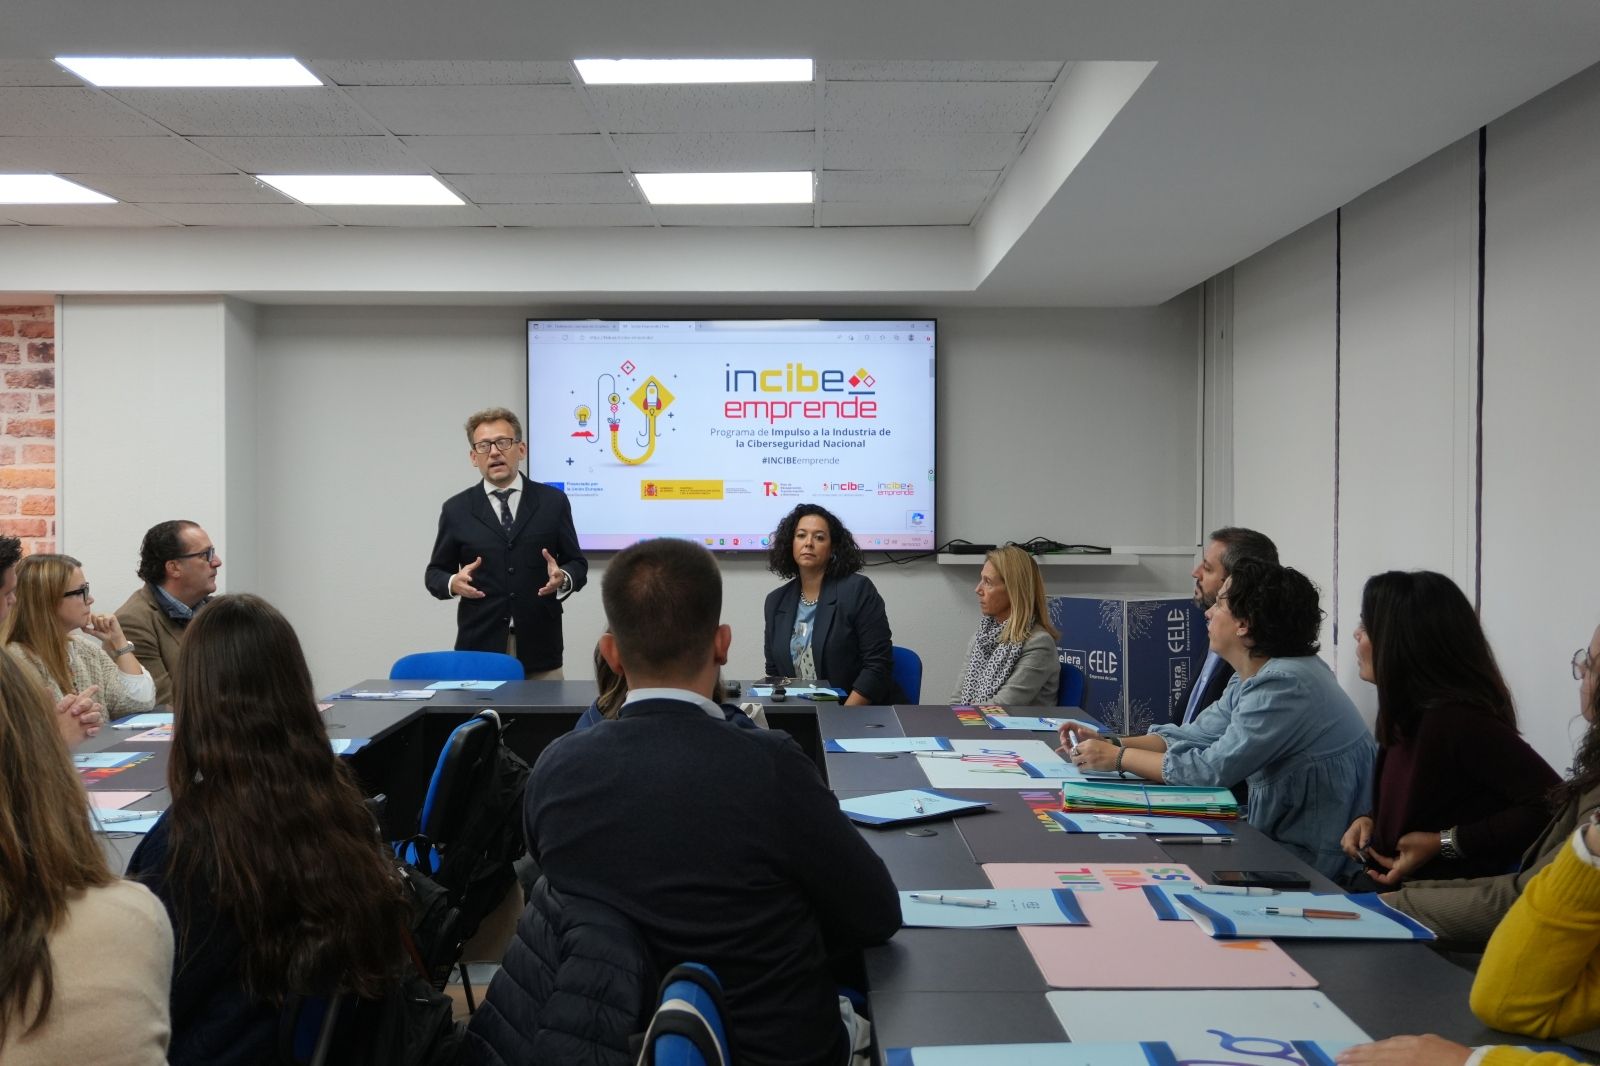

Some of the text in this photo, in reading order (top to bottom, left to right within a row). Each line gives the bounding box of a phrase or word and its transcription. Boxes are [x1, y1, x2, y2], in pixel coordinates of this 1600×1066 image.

[726, 363, 844, 392] incibe
[724, 396, 877, 424] emprende
[710, 428, 755, 438] Programa
[758, 428, 769, 436] de
[772, 428, 810, 438] Impulso
[821, 428, 830, 436] la
[832, 428, 876, 436] Industria
[878, 428, 891, 436] de
[736, 439, 866, 449] la Ciberseguridad Nacional
[762, 456, 840, 466] #INCIBEemprende
[1054, 868, 1105, 892] GIRL
[1102, 869, 1148, 890] YOU
